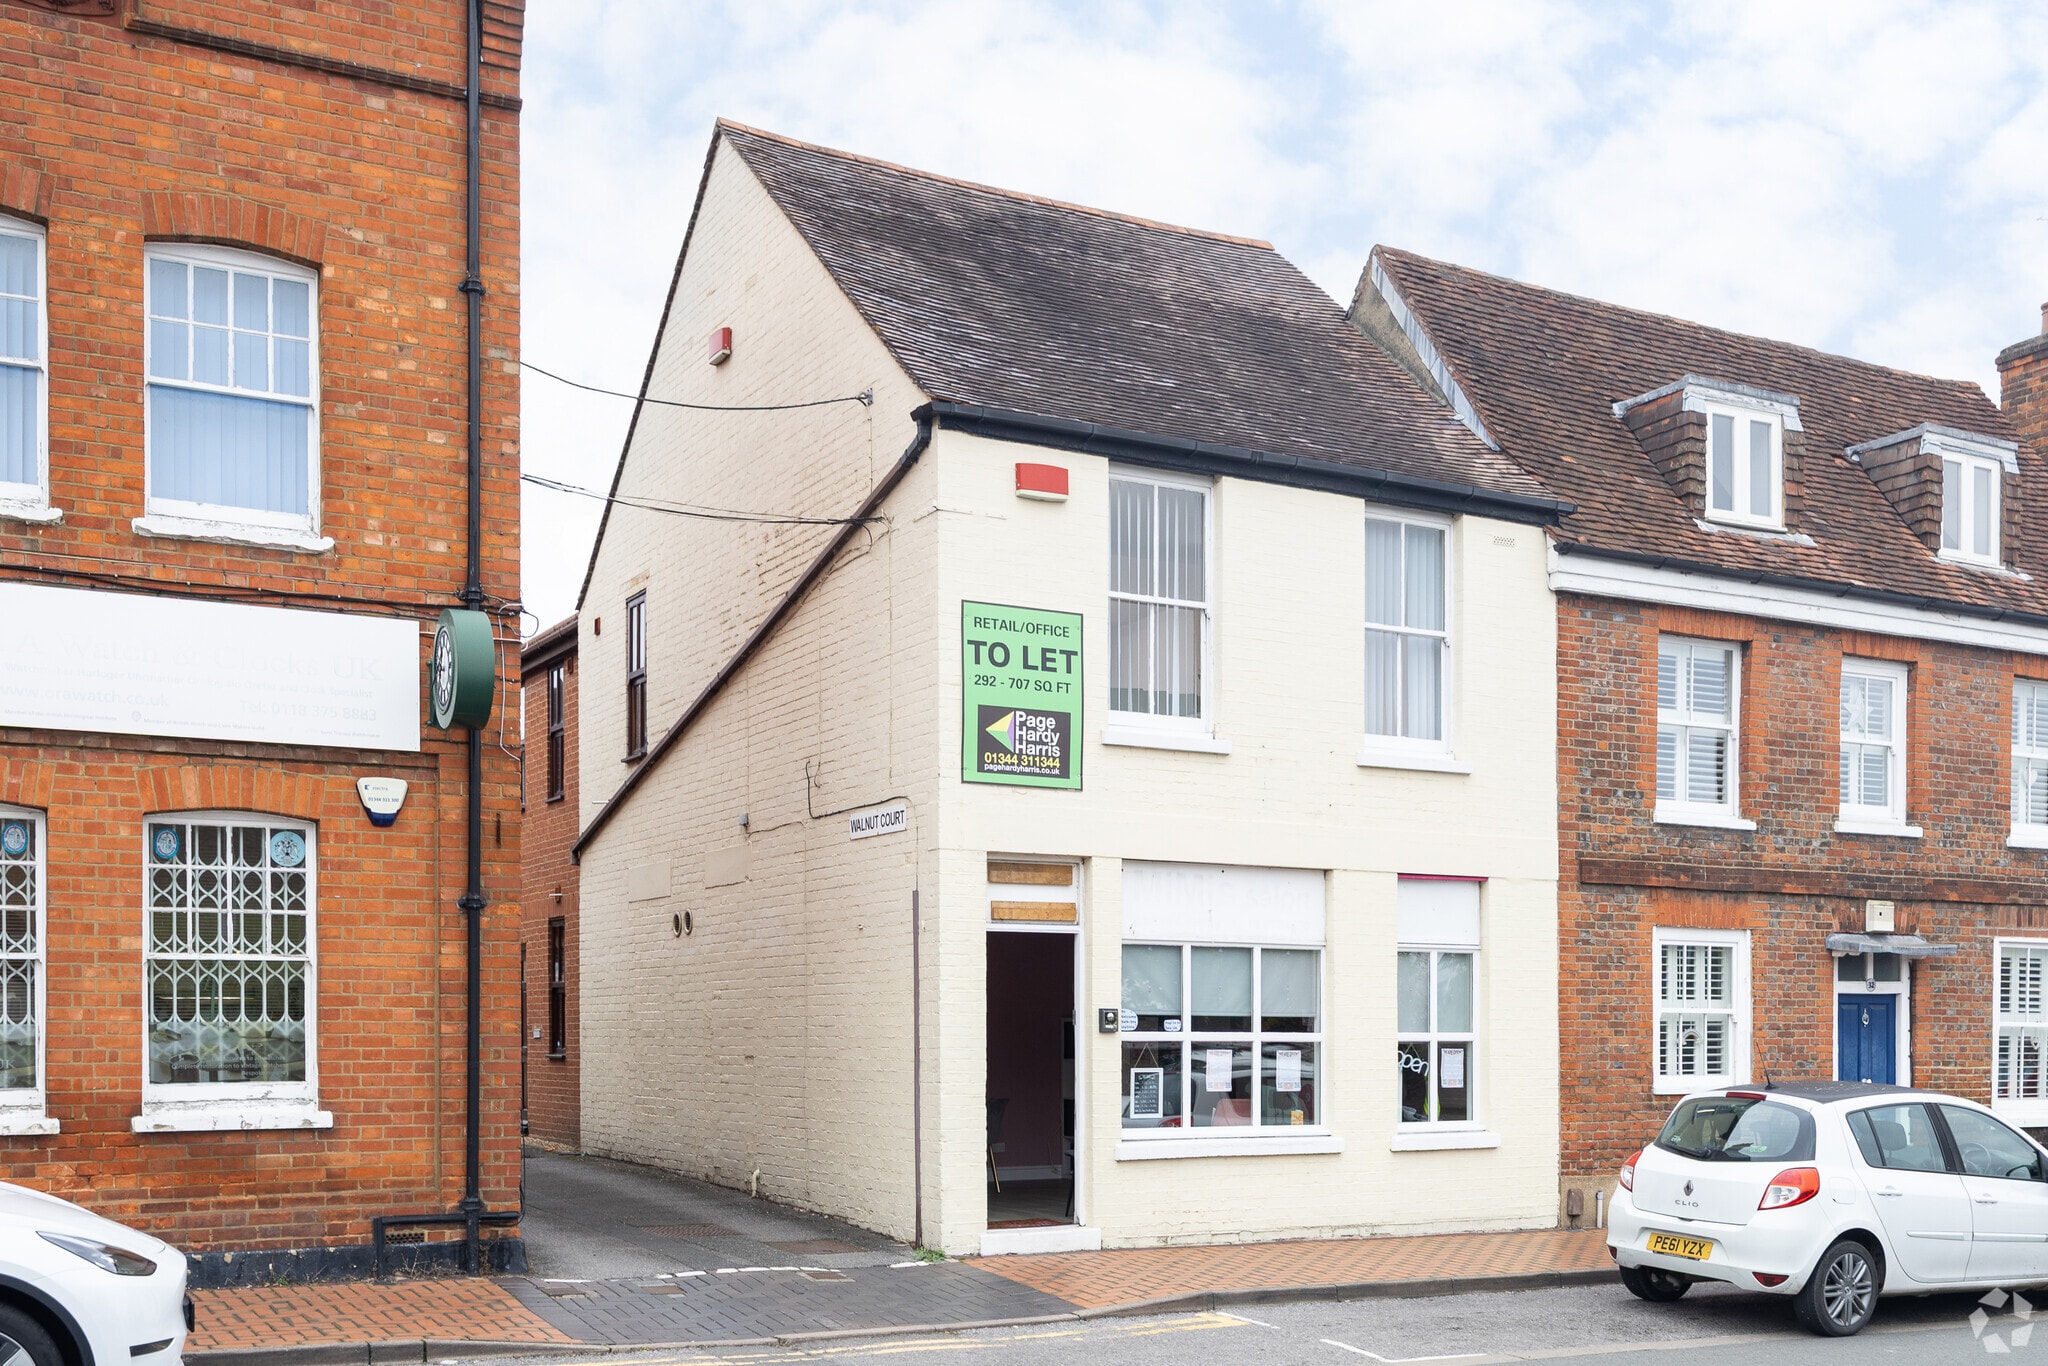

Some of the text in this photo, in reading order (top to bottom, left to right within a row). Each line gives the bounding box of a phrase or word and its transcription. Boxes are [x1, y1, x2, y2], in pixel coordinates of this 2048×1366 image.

[973, 616, 1070, 638] RETAIL/OFFICE
[966, 639, 1079, 675] TO LET
[332, 655, 384, 681] UK
[974, 674, 997, 687] 292
[1008, 677, 1030, 691] 707
[1034, 679, 1053, 693] SQ
[1056, 682, 1071, 694] FT
[271, 700, 307, 717] 0118
[1015, 711, 1056, 731] Page
[1015, 726, 1060, 746] Hardy
[1015, 740, 1060, 757] Harris
[984, 751, 1060, 769] 01344 311344
[984, 763, 1060, 776] pagehardyharris.co.uk
[850, 809, 905, 834] WALNUT COURT
[1674, 1199, 1699, 1208] CLIO
[1653, 1235, 1681, 1252] PE61
[1682, 1240, 1706, 1256] YZX
